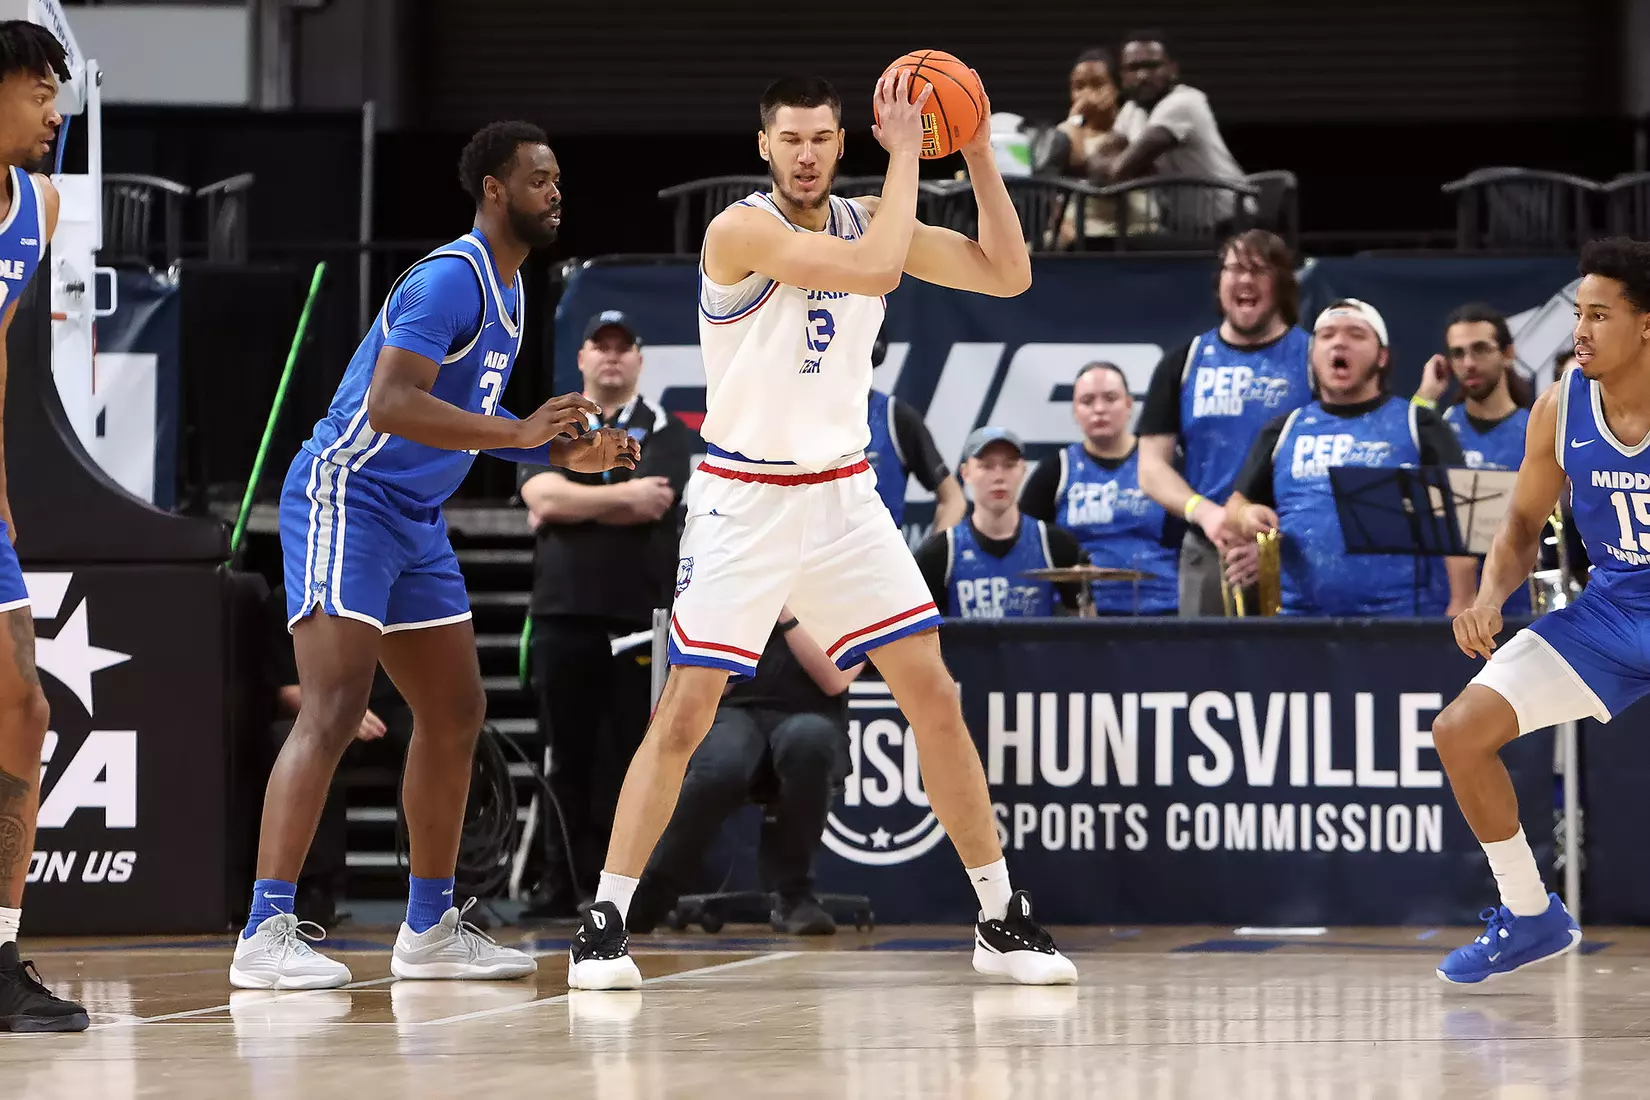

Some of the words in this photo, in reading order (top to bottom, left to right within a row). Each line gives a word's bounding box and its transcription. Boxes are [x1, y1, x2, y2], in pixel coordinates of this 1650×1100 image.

[0, 259, 25, 280] LE
[483, 350, 511, 370] MID
[1194, 366, 1254, 397] PEP
[1193, 396, 1243, 417] BAND
[1293, 434, 1355, 465] PEP
[1068, 480, 1119, 508] PEP
[1592, 471, 1650, 490] MIDD
[956, 576, 1009, 609] PEP
[988, 691, 1443, 788] HUNTSVILLE
[1167, 803, 1443, 852] COMMISSION
[82, 851, 136, 882] US
